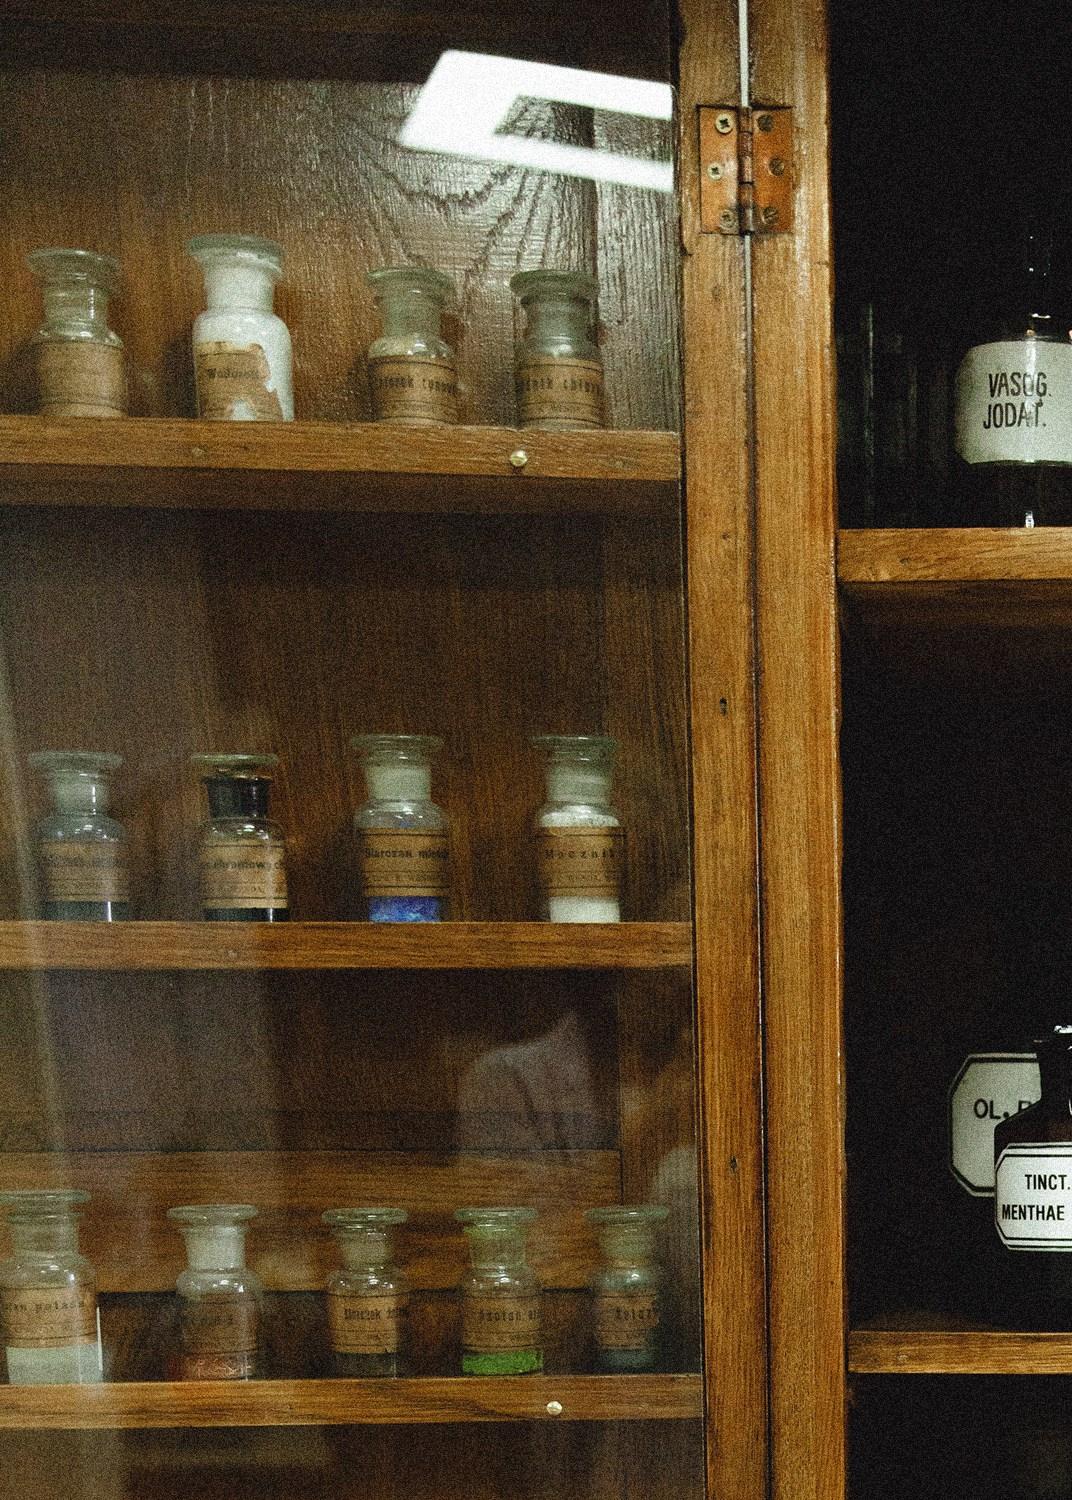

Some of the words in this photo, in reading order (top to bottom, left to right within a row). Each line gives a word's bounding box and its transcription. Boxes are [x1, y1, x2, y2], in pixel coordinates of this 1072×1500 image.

[988, 371, 1052, 398] VASOG.
[983, 402, 1047, 430] JODAT.
[973, 1097, 1010, 1120] OL.
[1024, 1174, 1071, 1191] TINCT.
[1002, 1204, 1065, 1221] MENTHAE
